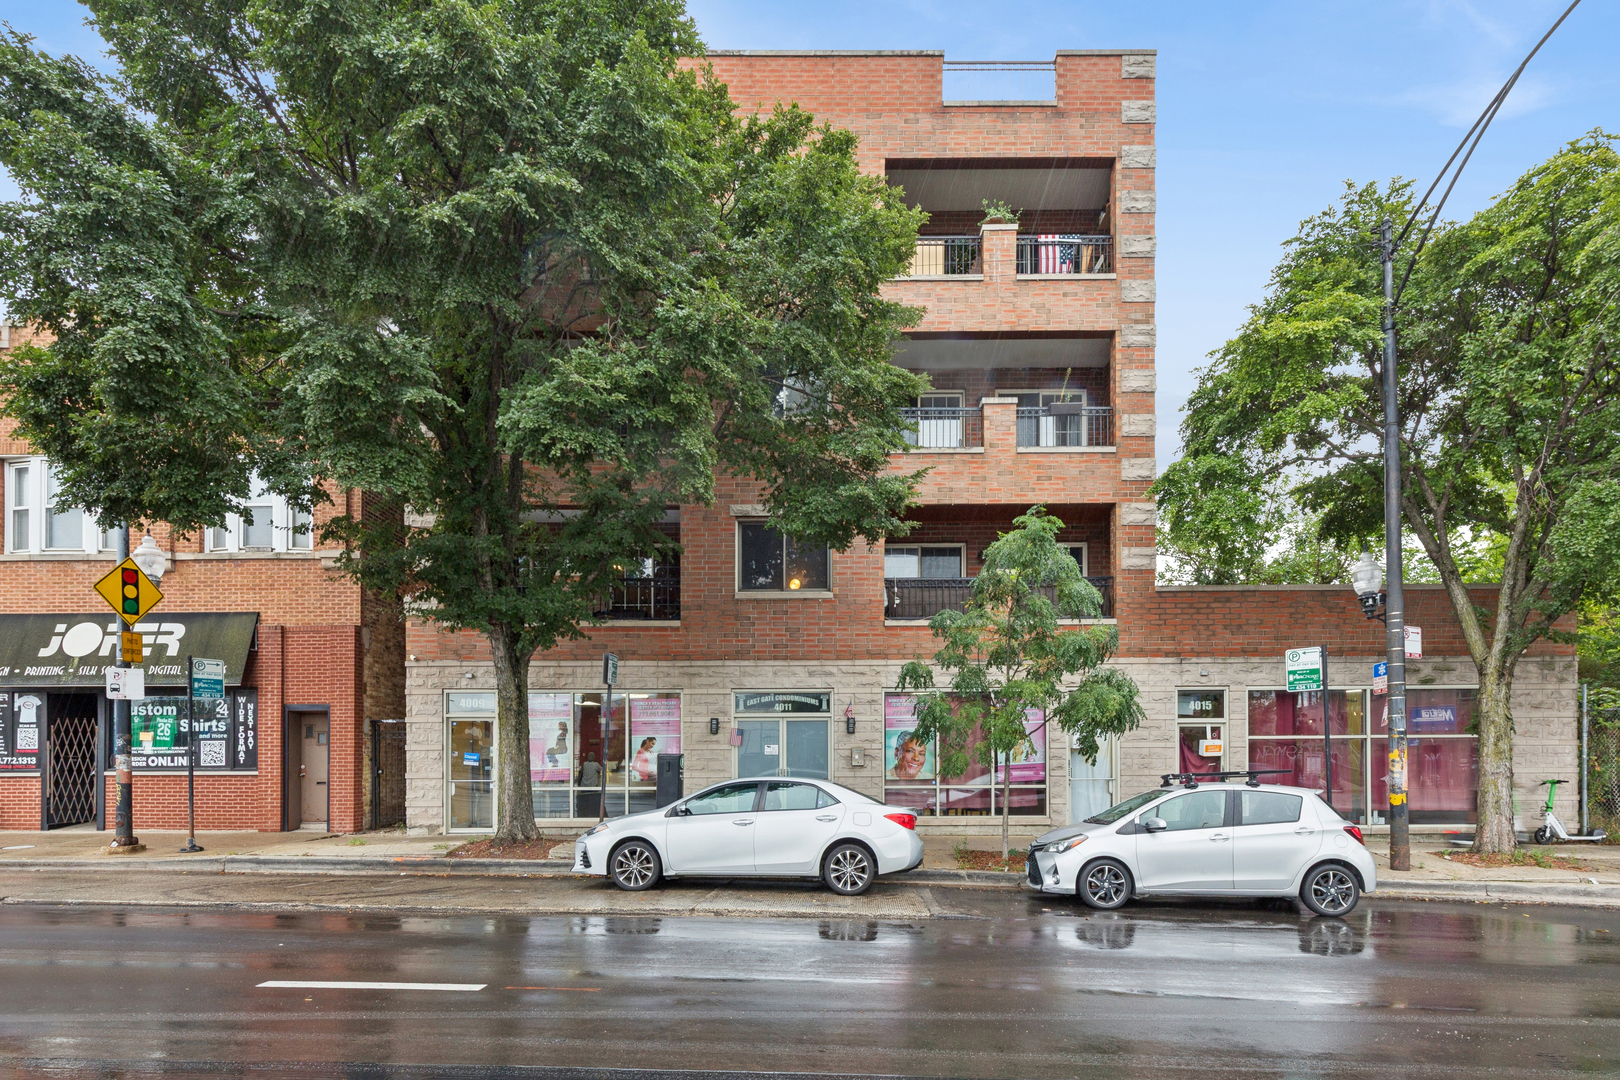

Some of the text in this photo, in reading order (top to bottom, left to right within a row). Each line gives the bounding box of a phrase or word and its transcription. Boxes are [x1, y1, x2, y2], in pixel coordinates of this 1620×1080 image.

[24, 666, 65, 676] PRINTING
[78, 666, 98, 676] SILK
[148, 665, 181, 675] DIGITAL
[460, 698, 485, 708] 4009
[746, 694, 820, 706] EAST GATE CONDOMINIUMS
[1189, 700, 1212, 711] 4015
[774, 703, 792, 711] 4011
[157, 723, 171, 736] 26
[180, 718, 227, 732] Shirts
[237, 696, 246, 764] WIDE FORMAT
